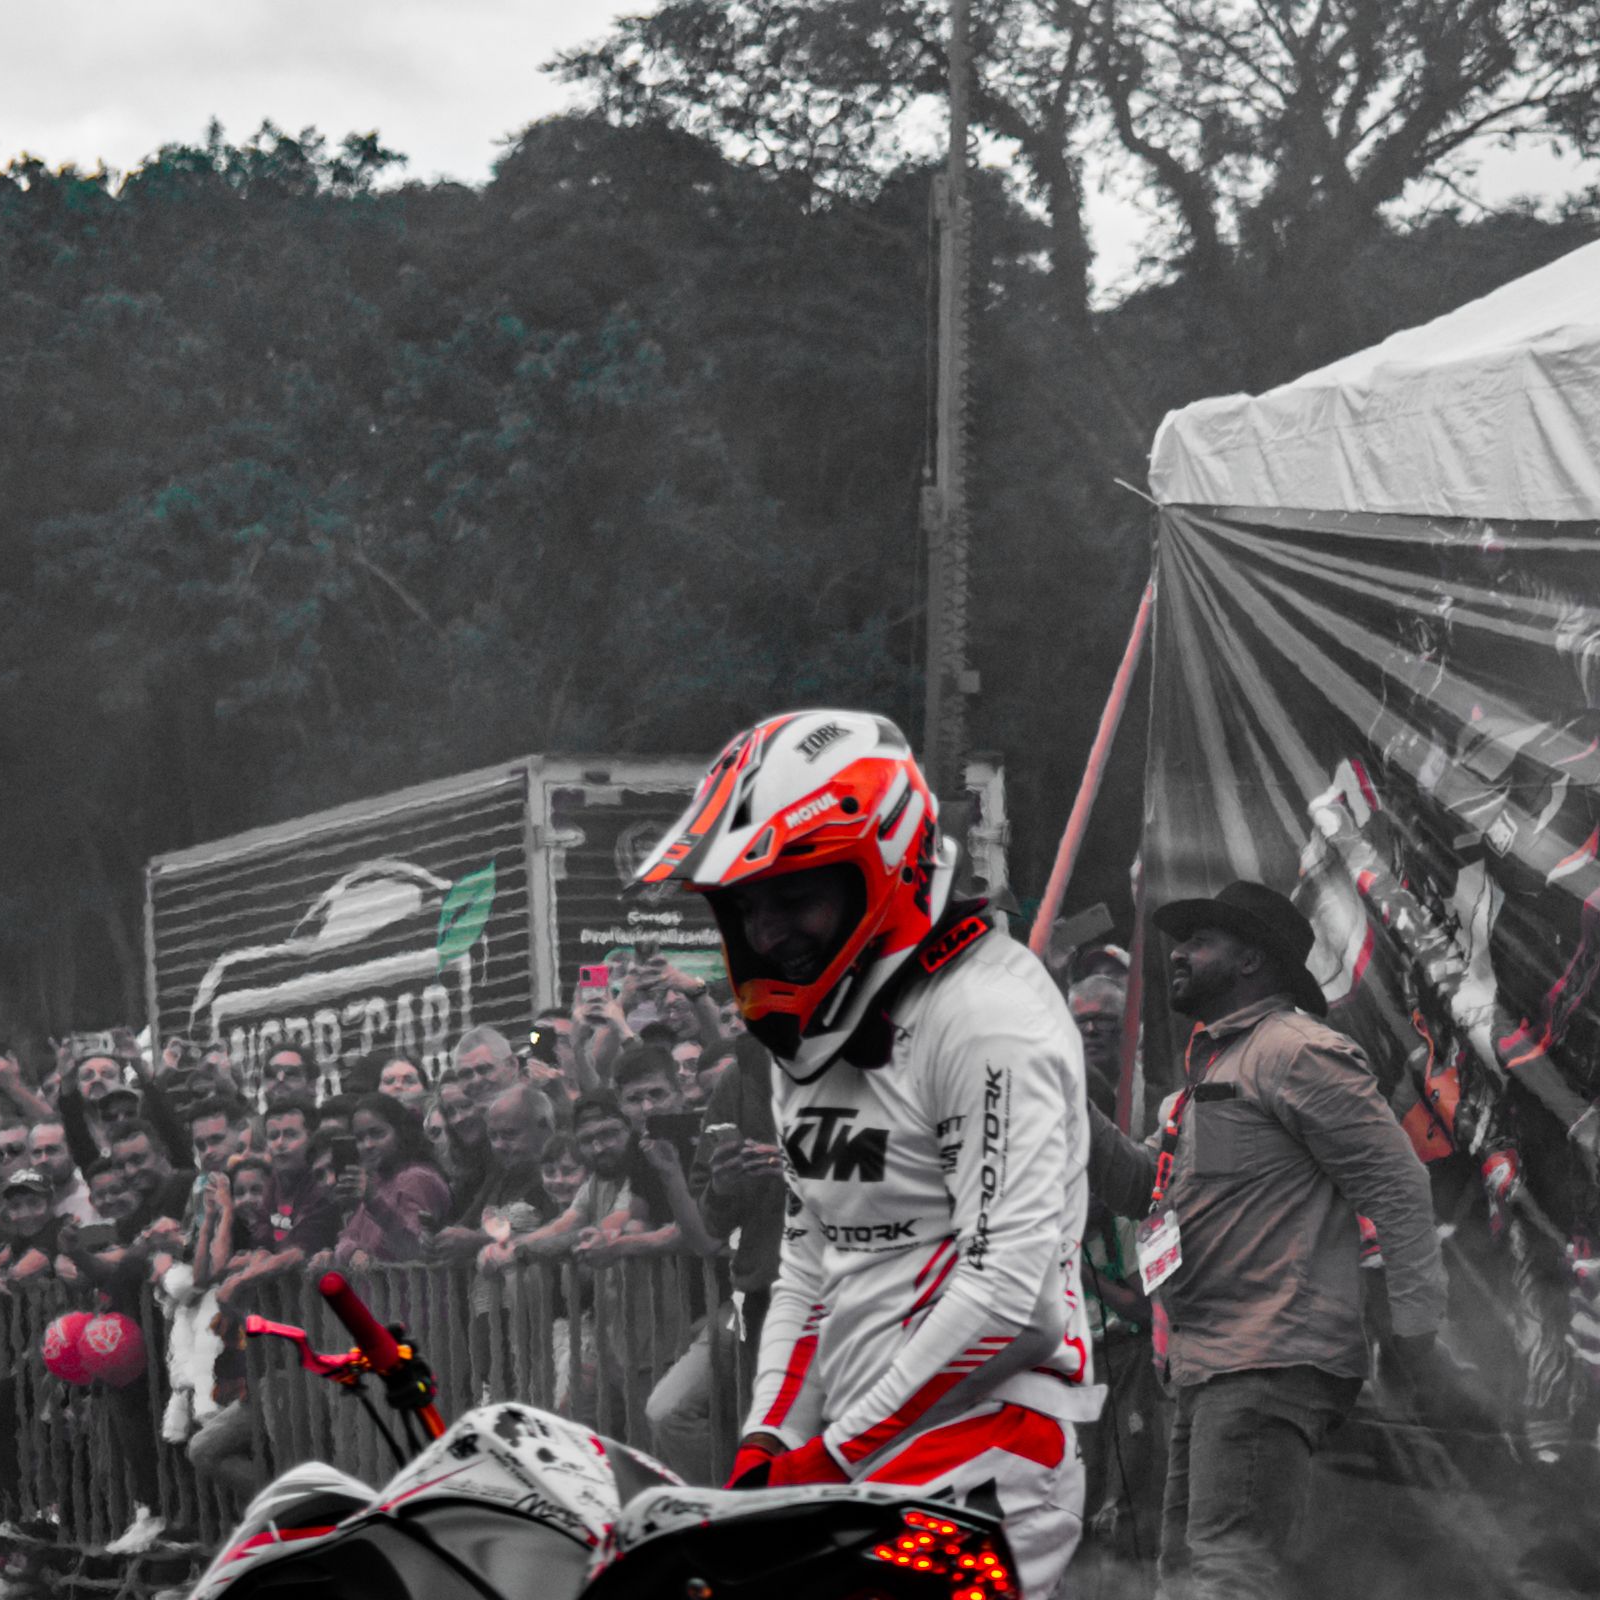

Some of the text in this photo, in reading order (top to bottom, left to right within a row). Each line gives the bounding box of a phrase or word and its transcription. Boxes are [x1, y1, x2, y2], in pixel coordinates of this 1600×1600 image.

[796, 722, 853, 758] TORK
[785, 793, 839, 829] MOTUL
[927, 921, 980, 967] KTM
[982, 1062, 1003, 1160] TORK
[783, 1106, 890, 1183] KTM
[842, 1217, 922, 1244] TORK
